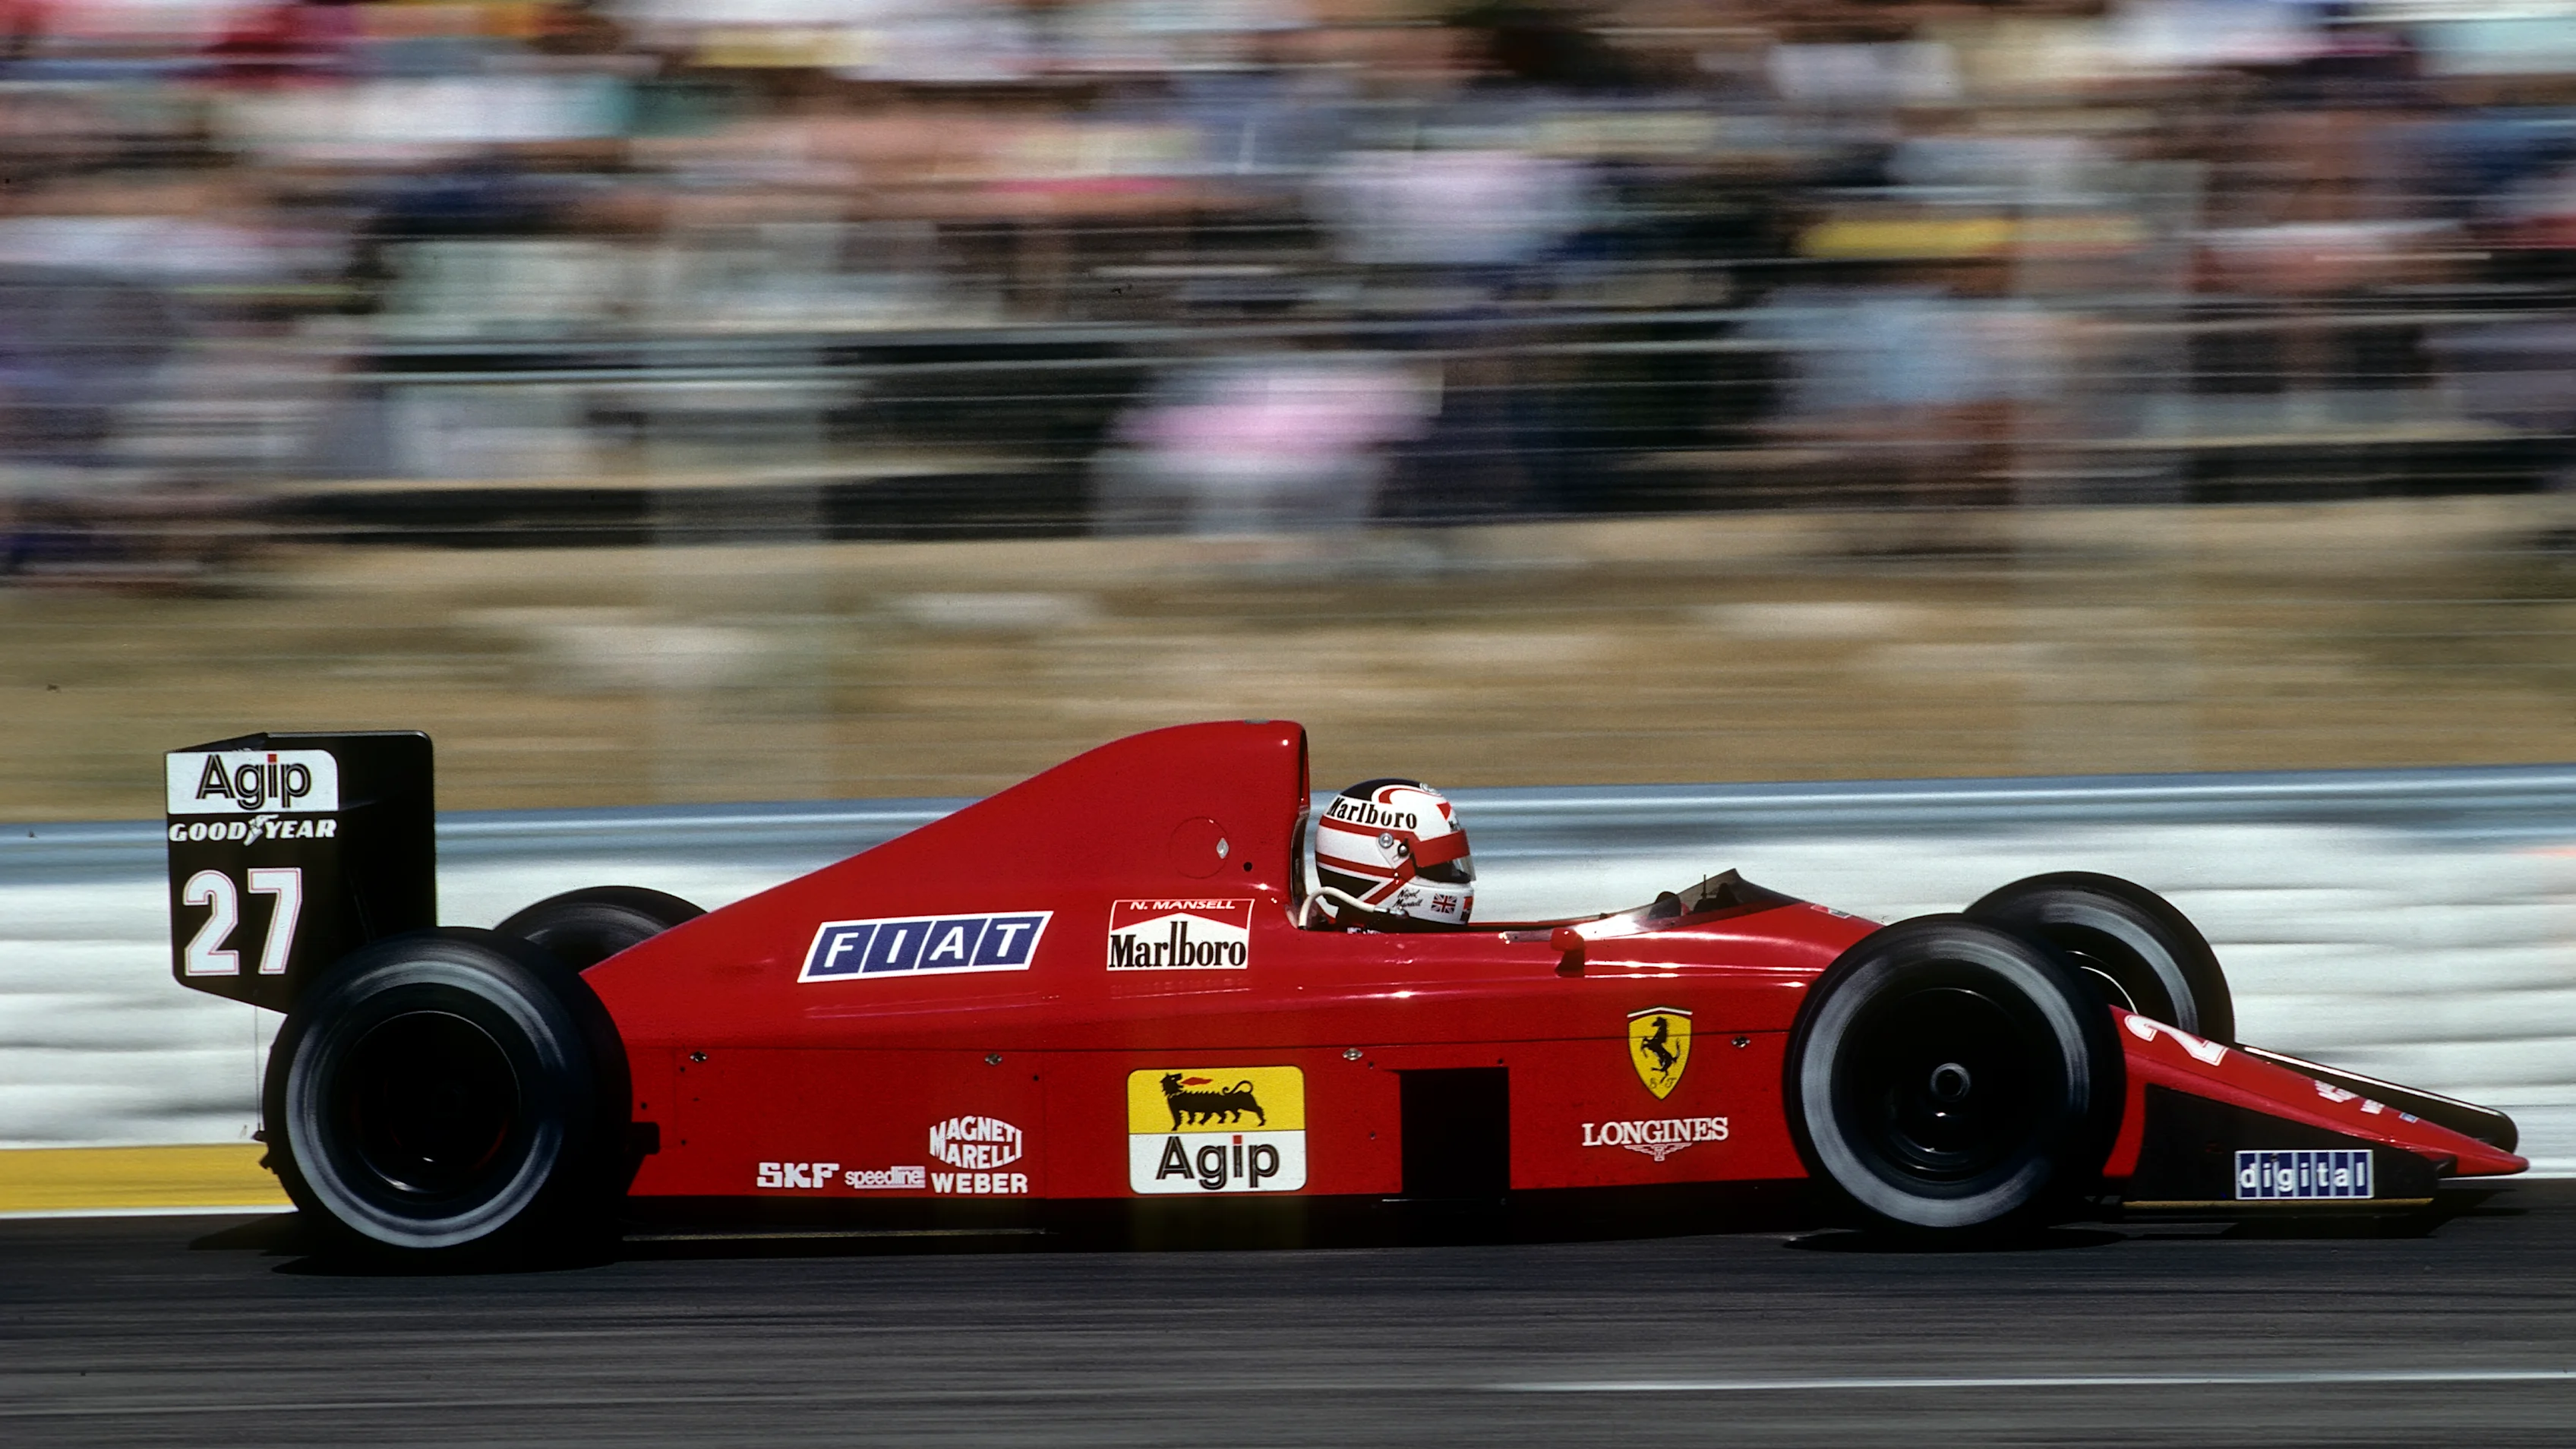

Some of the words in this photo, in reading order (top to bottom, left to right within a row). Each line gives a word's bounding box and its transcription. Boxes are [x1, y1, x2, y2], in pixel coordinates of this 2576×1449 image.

[195, 753, 311, 810] Agip
[1326, 797, 1418, 829] Marlboro
[1129, 901, 1149, 910] N.
[1152, 901, 1236, 910] MANSELL
[182, 867, 303, 977] 27
[823, 923, 1031, 968] FIAT
[1109, 920, 1247, 968] Marlboro
[929, 1115, 1022, 1144] MAGNETI
[1581, 1116, 1728, 1146] LONGINES
[757, 1163, 840, 1189] SKF
[844, 1166, 926, 1189] speedline
[1155, 1135, 1280, 1190] Agip
[2240, 1162, 2365, 1192] digital
[930, 1173, 1028, 1194] WEBER
